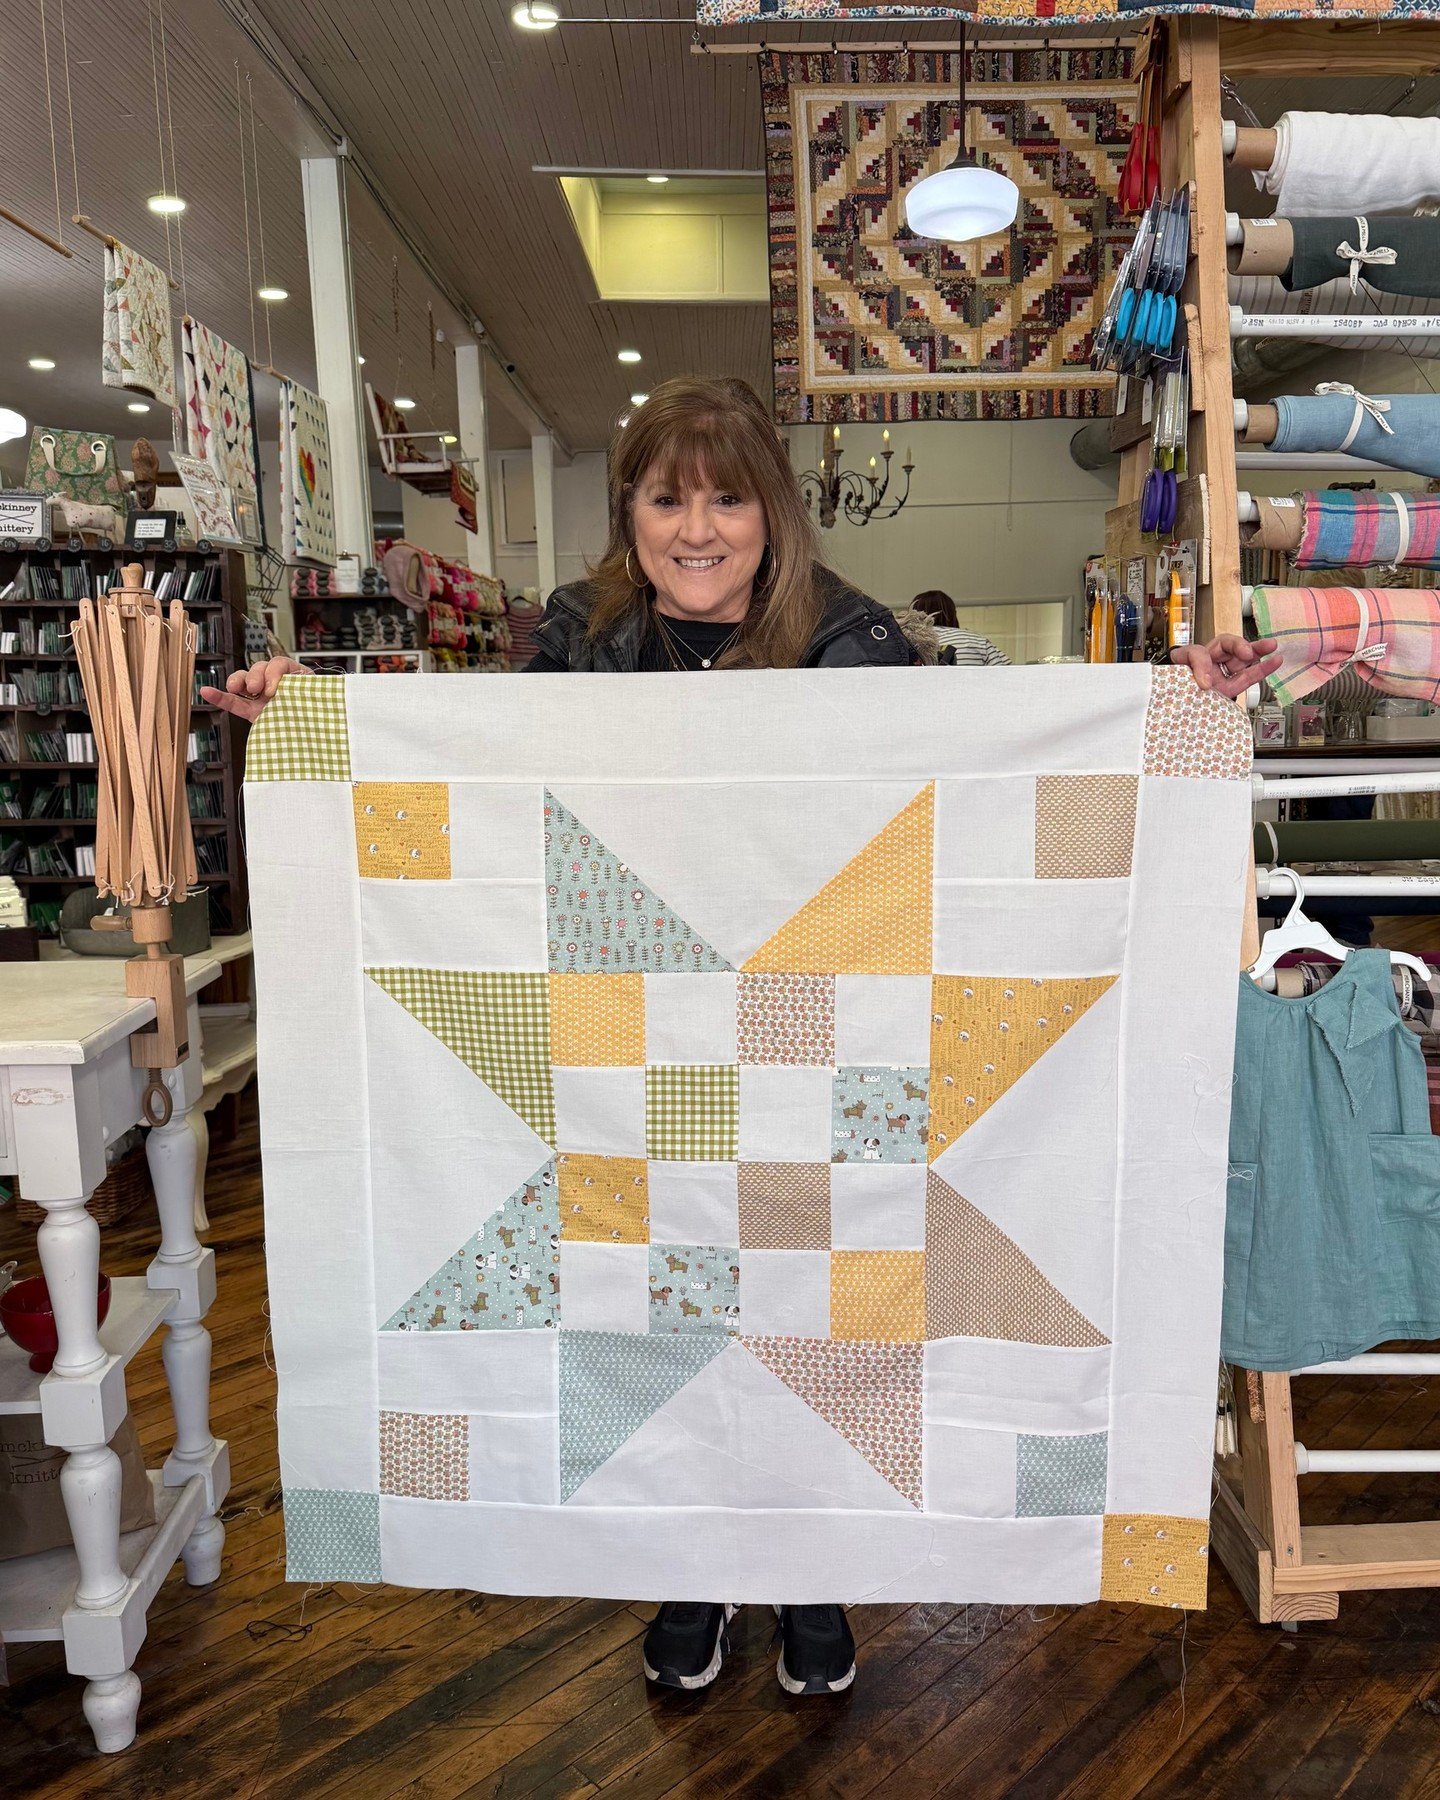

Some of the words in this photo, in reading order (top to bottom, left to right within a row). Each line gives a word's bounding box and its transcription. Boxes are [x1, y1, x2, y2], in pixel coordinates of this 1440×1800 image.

[1332, 319, 1363, 328] 480PSI
[1373, 319, 1388, 328] PVC
[1392, 318, 1417, 328] SCH40
[0, 503, 37, 514] kinney
[10, 1467, 62, 1484] knitt
